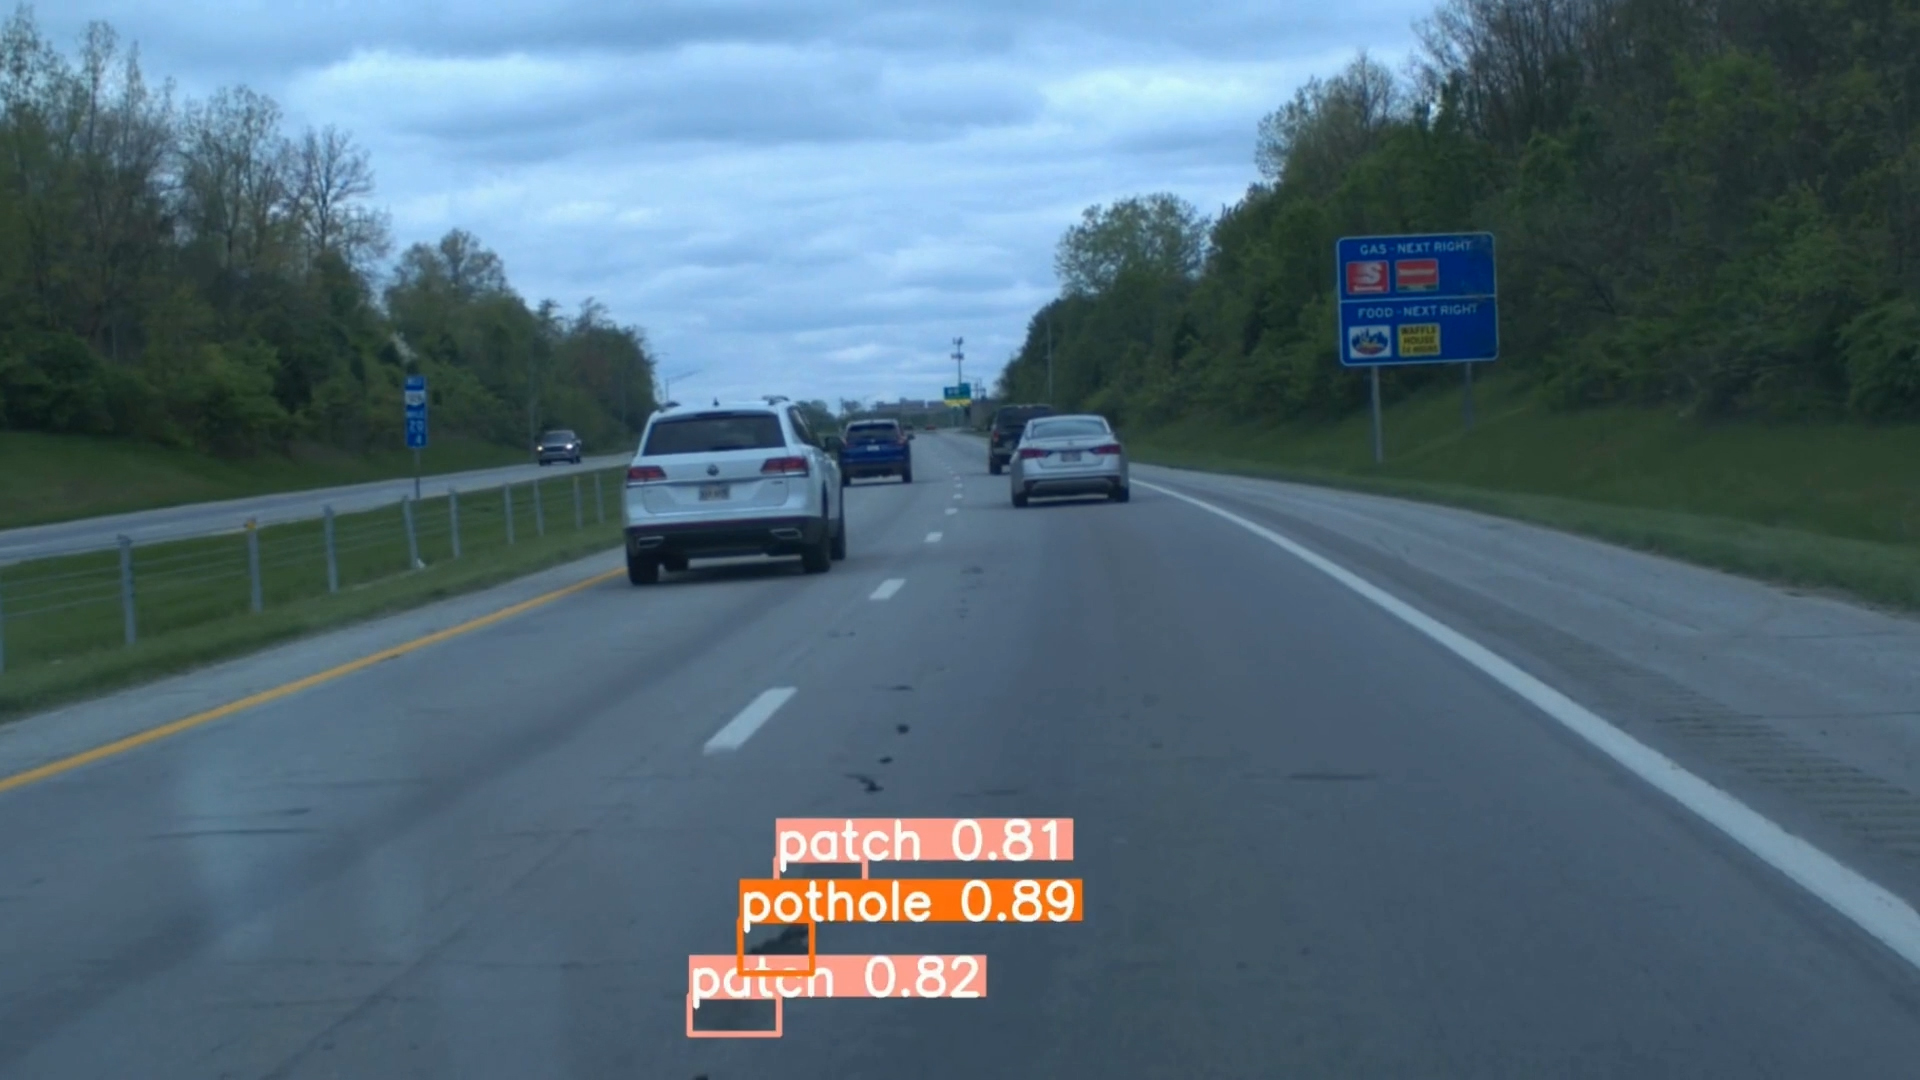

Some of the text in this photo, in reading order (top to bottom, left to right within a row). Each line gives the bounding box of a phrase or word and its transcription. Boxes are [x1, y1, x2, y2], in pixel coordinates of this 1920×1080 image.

[1360, 244, 1387, 256] GAS
[1397, 242, 1431, 254] NEXT
[1434, 241, 1472, 252] RIGHT
[1358, 307, 1393, 319] FOOD
[1403, 305, 1437, 317] NEXT
[1440, 303, 1478, 315] RIGHT
[1400, 326, 1436, 335] WAFFLE
[1403, 335, 1435, 345] HOUSE
